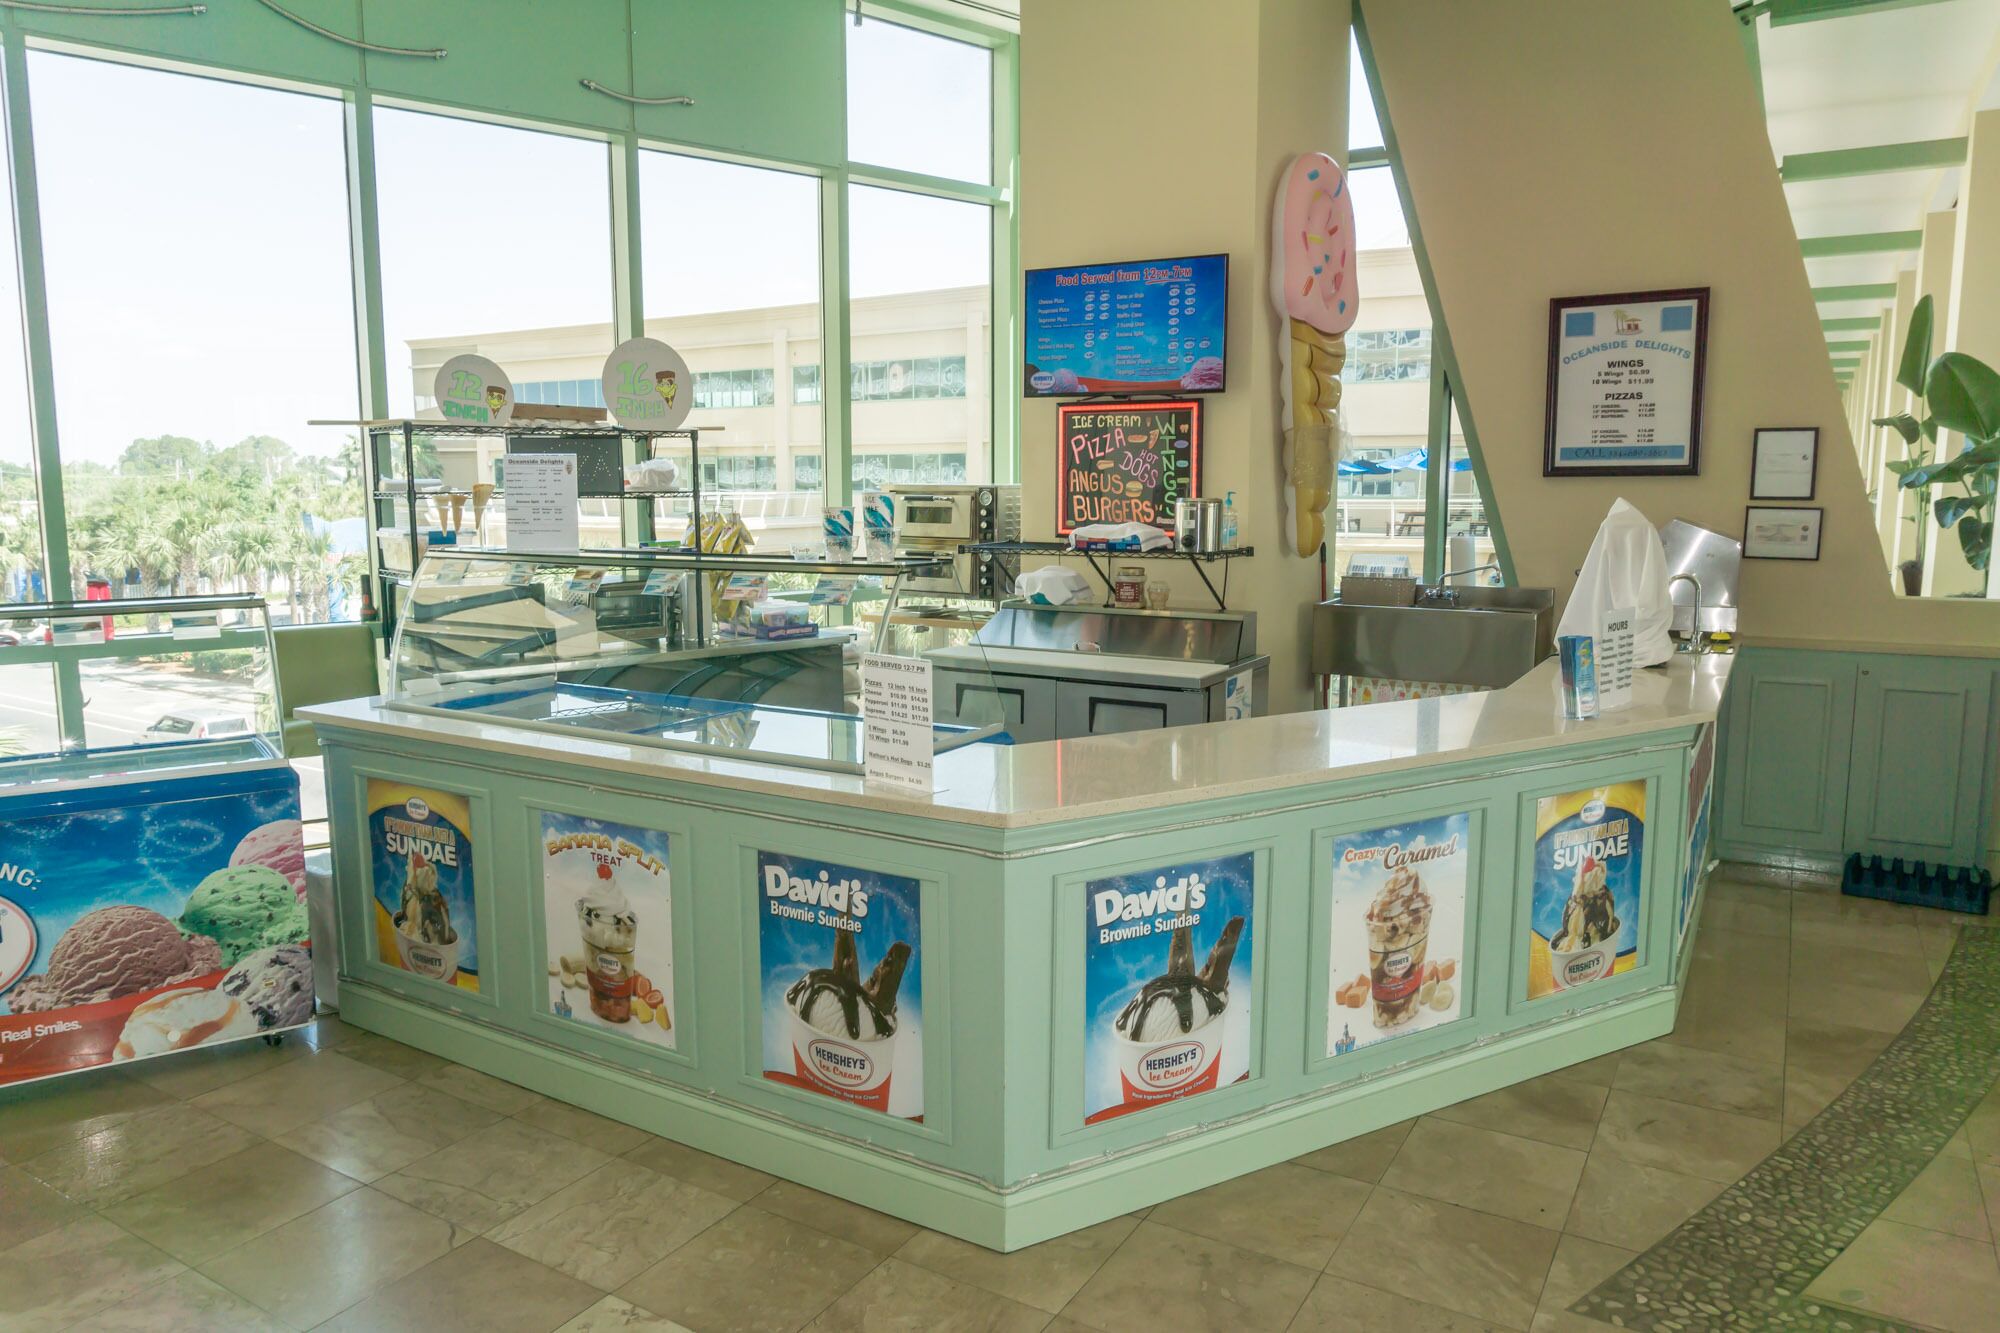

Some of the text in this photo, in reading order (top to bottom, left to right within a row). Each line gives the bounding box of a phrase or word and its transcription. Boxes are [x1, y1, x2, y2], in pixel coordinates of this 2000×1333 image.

[1056, 273, 1078, 287] Food
[1081, 271, 1114, 285] Served
[1117, 269, 1140, 282] from
[1563, 340, 1691, 365] OCEANSIDE DELIGHTS
[1607, 360, 1644, 368] WINGS
[448, 370, 482, 400] 12
[616, 360, 653, 396] 16
[1605, 392, 1643, 400] PIZZAS
[443, 400, 488, 424] INCH
[616, 397, 665, 419] INCH
[1072, 415, 1140, 429] ICE CREAM
[1140, 449, 1159, 465] HOT
[1575, 448, 1605, 458] CALL
[1119, 451, 1158, 488] DOGS
[1155, 413, 1178, 516] WINGS
[1070, 468, 1124, 494] ANGUS
[1073, 495, 1154, 523] BURGERS
[1608, 620, 1628, 632] HOURS
[864, 659, 879, 667] FOOD
[880, 660, 902, 670] SERVED
[903, 664, 915, 672] 12-7
[865, 678, 882, 687] Pizzas
[895, 683, 906, 691] Inch
[915, 686, 927, 694] Inch
[865, 688, 882, 696] Cheese
[911, 695, 928, 704] $14.99
[865, 697, 888, 706] Pepperoni
[865, 706, 886, 715] Supreme
[912, 713, 929, 722] $17.99
[872, 726, 887, 735] Wings
[875, 735, 890, 743] Wings
[386, 833, 457, 867] SUNDAE
[546, 833, 664, 876] BANANA SPLIT
[591, 852, 622, 867] TREAT
[1344, 833, 1459, 870] Crazy for Caramel
[1553, 834, 1629, 870] SUNDAE
[764, 865, 869, 918] David's
[1094, 873, 1207, 927] David's
[770, 900, 863, 933] Brownie Sundae
[1100, 913, 1201, 945] Brownie Sundae
[1568, 956, 1600, 974] HERSHEY'S
[1, 1020, 83, 1044] Real Smiles.
[815, 1046, 866, 1070] HERSHEY'S
[1146, 1048, 1197, 1071] HERSHEY'S
[819, 1060, 863, 1081] Ice Cream
[1149, 1065, 1193, 1082] Ice Cream
